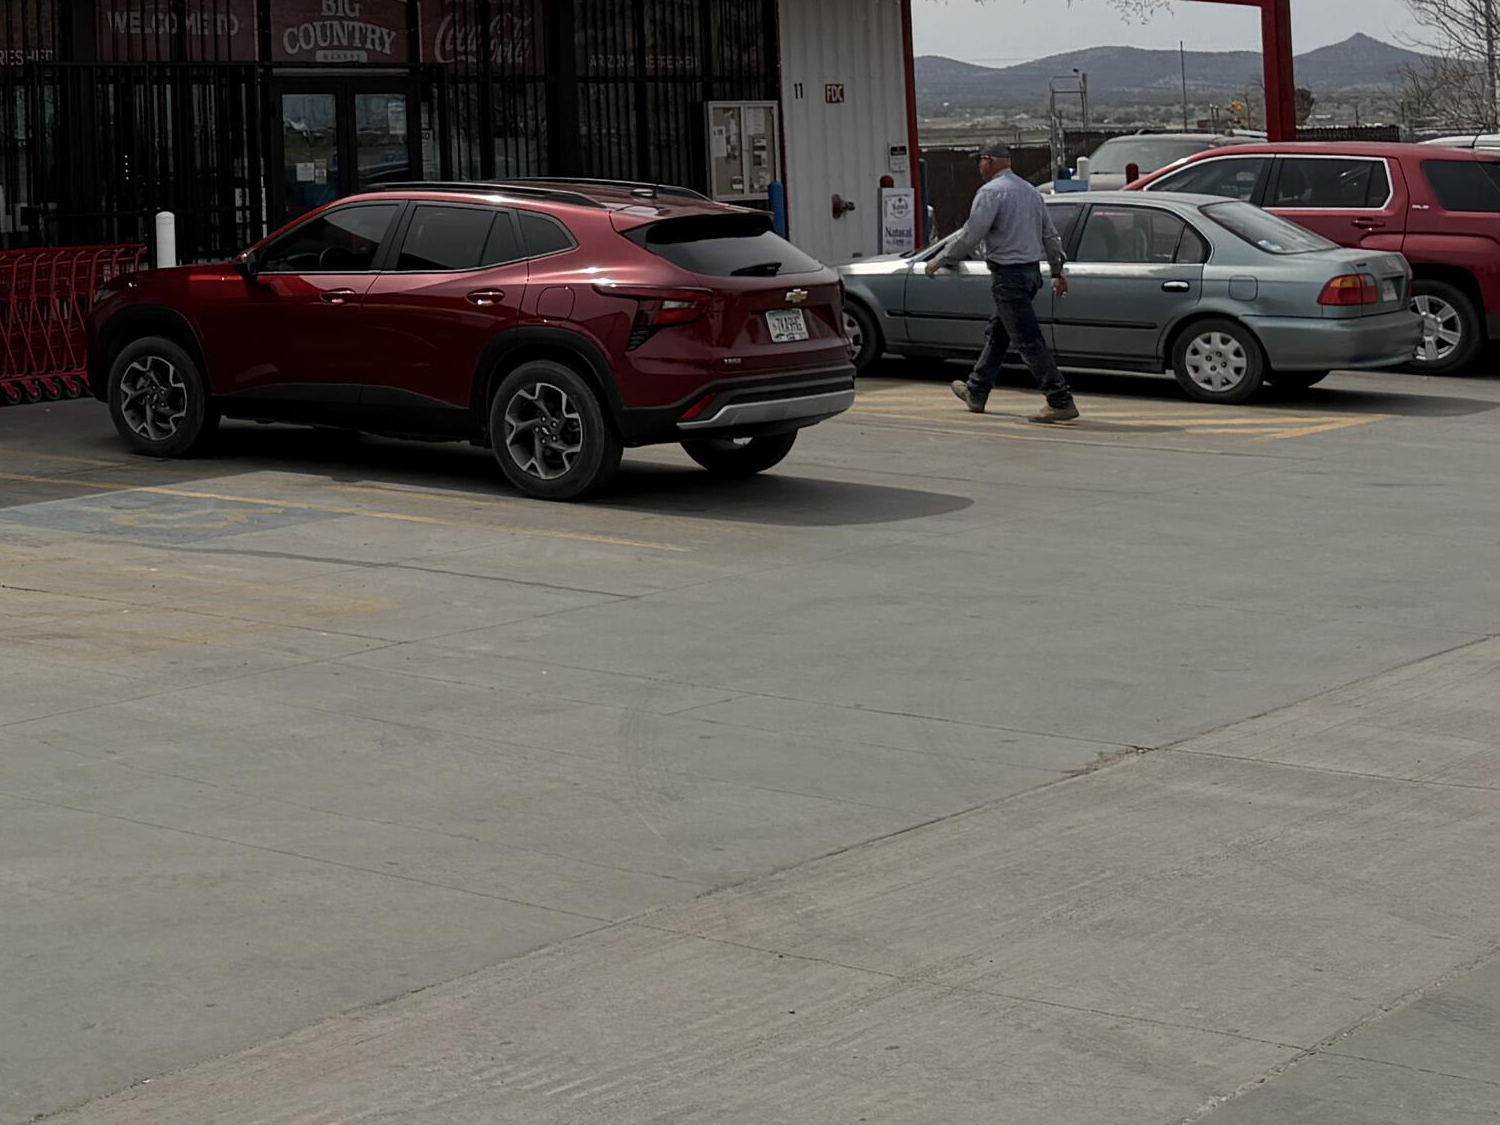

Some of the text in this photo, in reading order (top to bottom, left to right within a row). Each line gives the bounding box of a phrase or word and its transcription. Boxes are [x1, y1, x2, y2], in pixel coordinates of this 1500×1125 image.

[283, 20, 397, 55] COUNTRY
[587, 54, 636, 68] ARZNA
[826, 85, 843, 101] FDC
